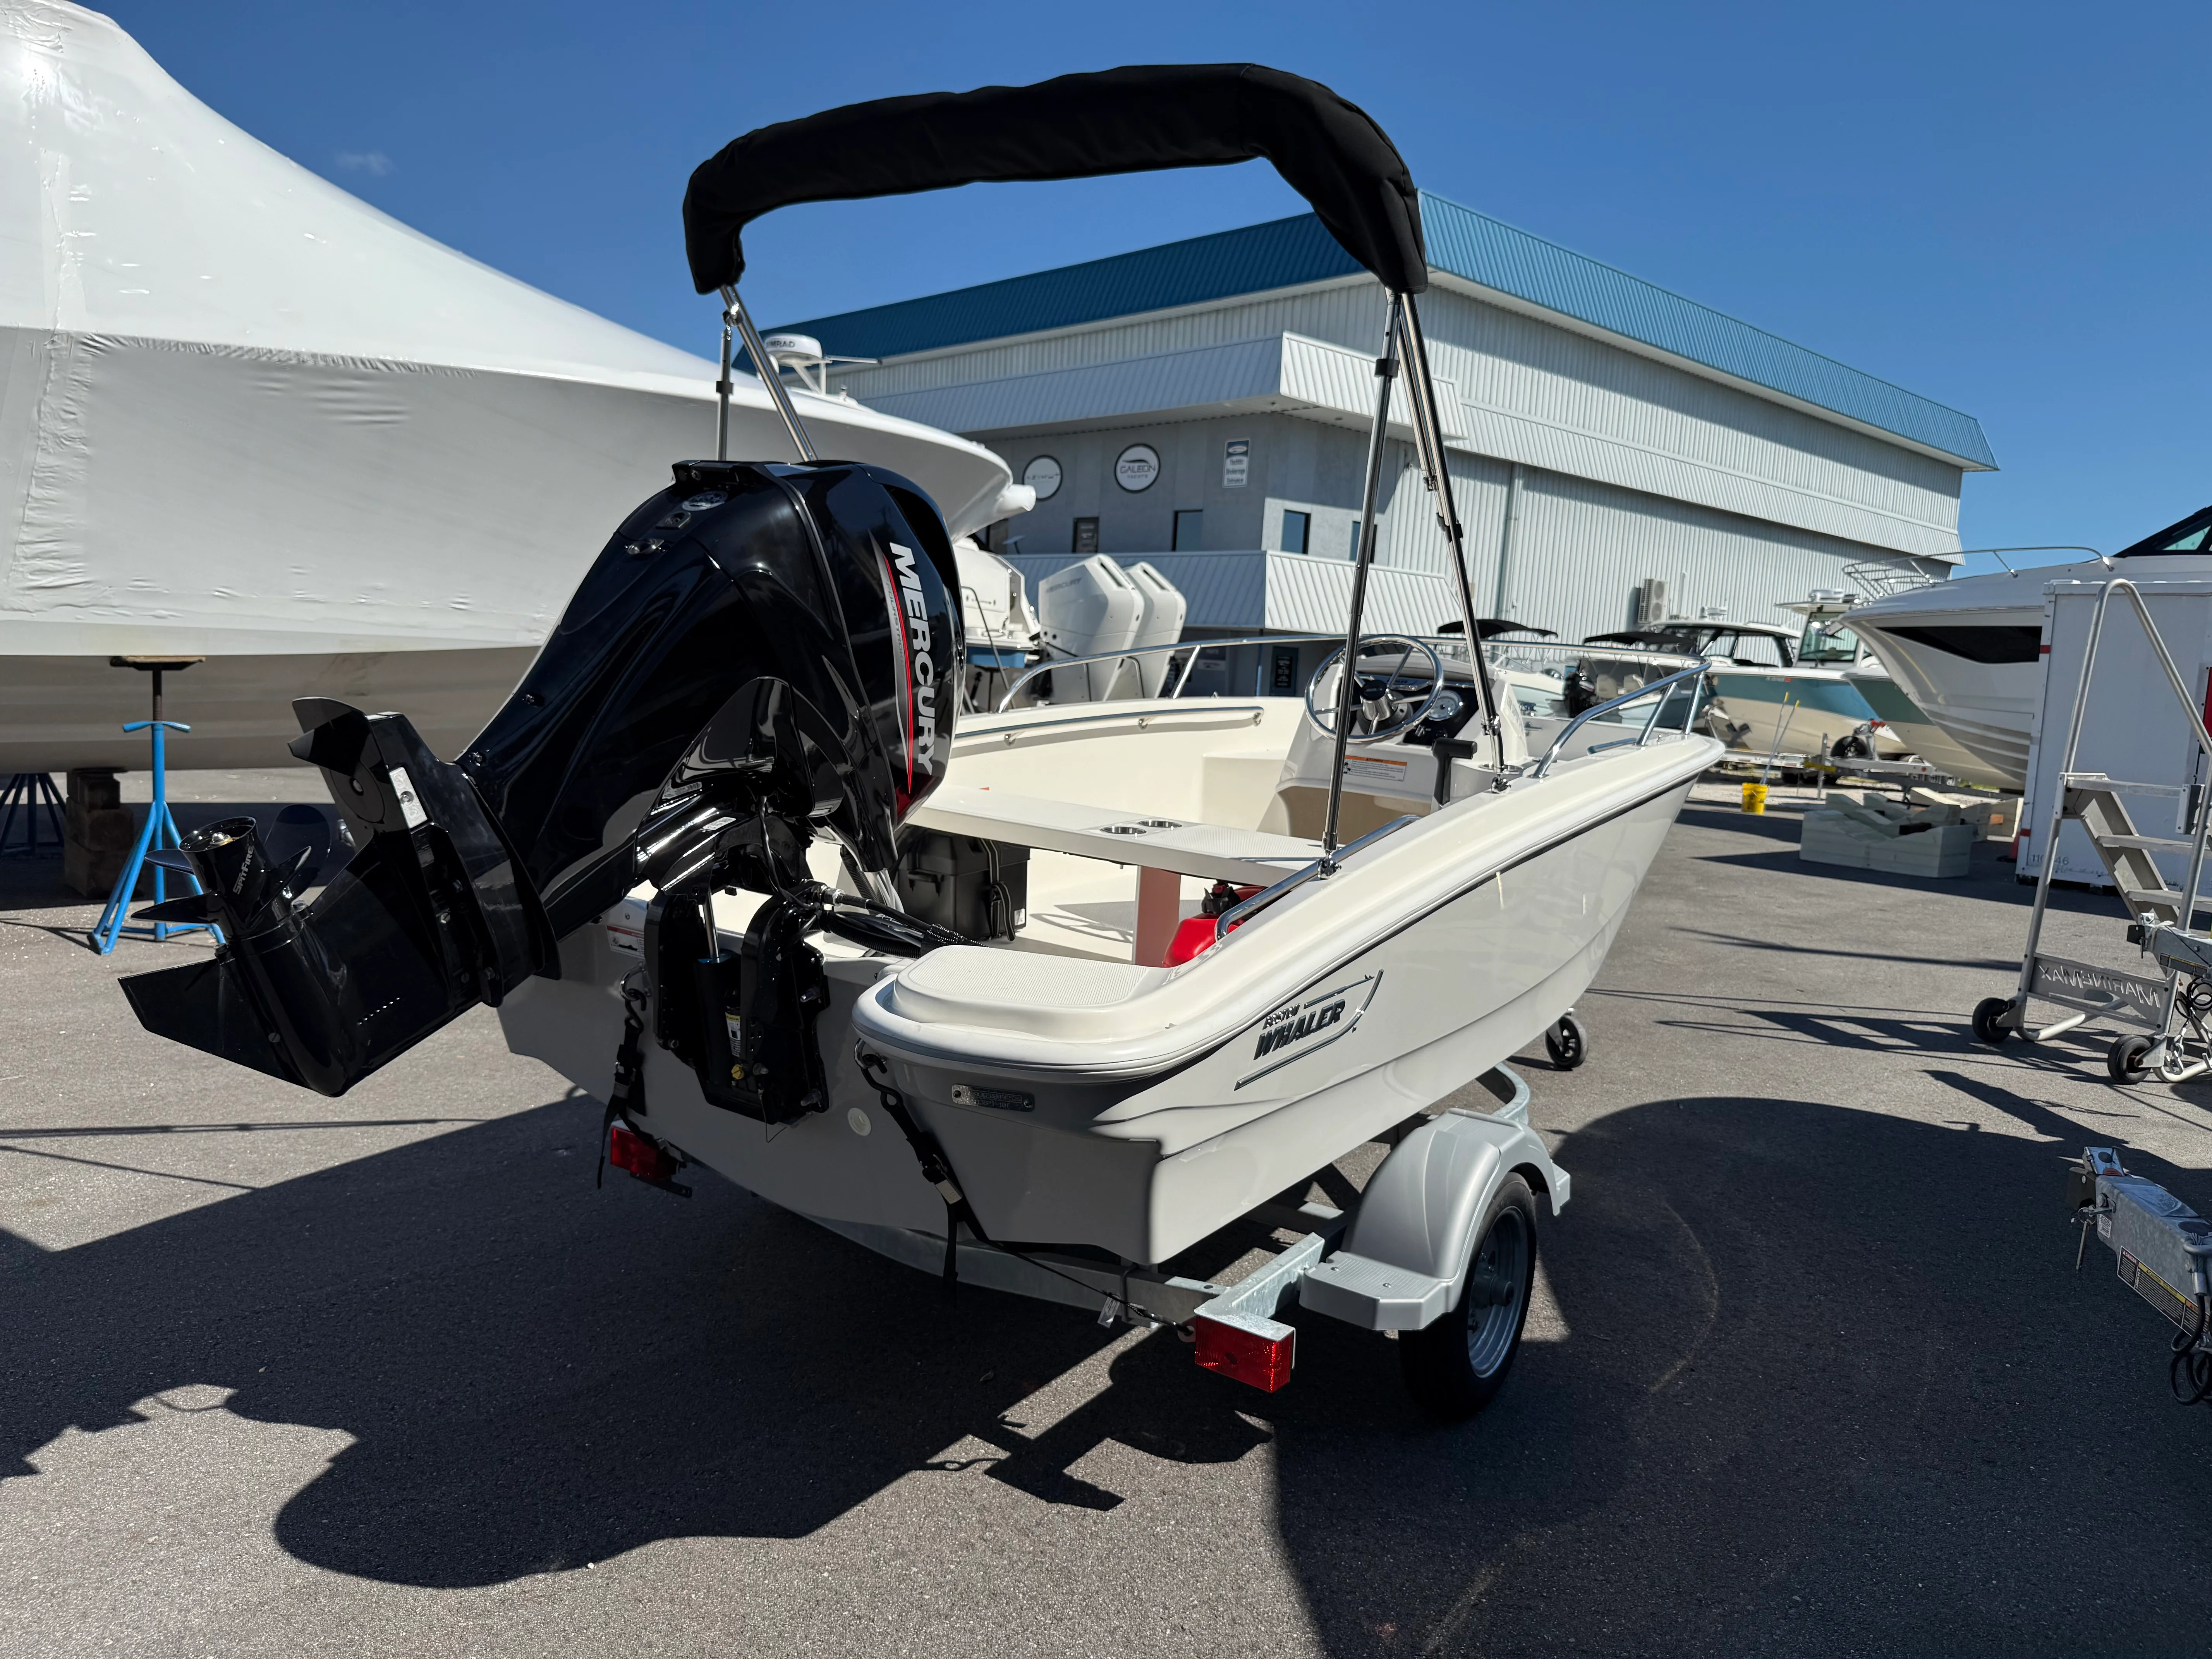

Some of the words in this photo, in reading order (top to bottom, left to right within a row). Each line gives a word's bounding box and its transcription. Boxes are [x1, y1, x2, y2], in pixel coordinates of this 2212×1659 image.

[1120, 464, 1156, 474] GALEON
[889, 542, 936, 776] MERCURY
[1253, 998, 1346, 1061] WHALER
[1262, 1003, 1301, 1030] BOSTON
